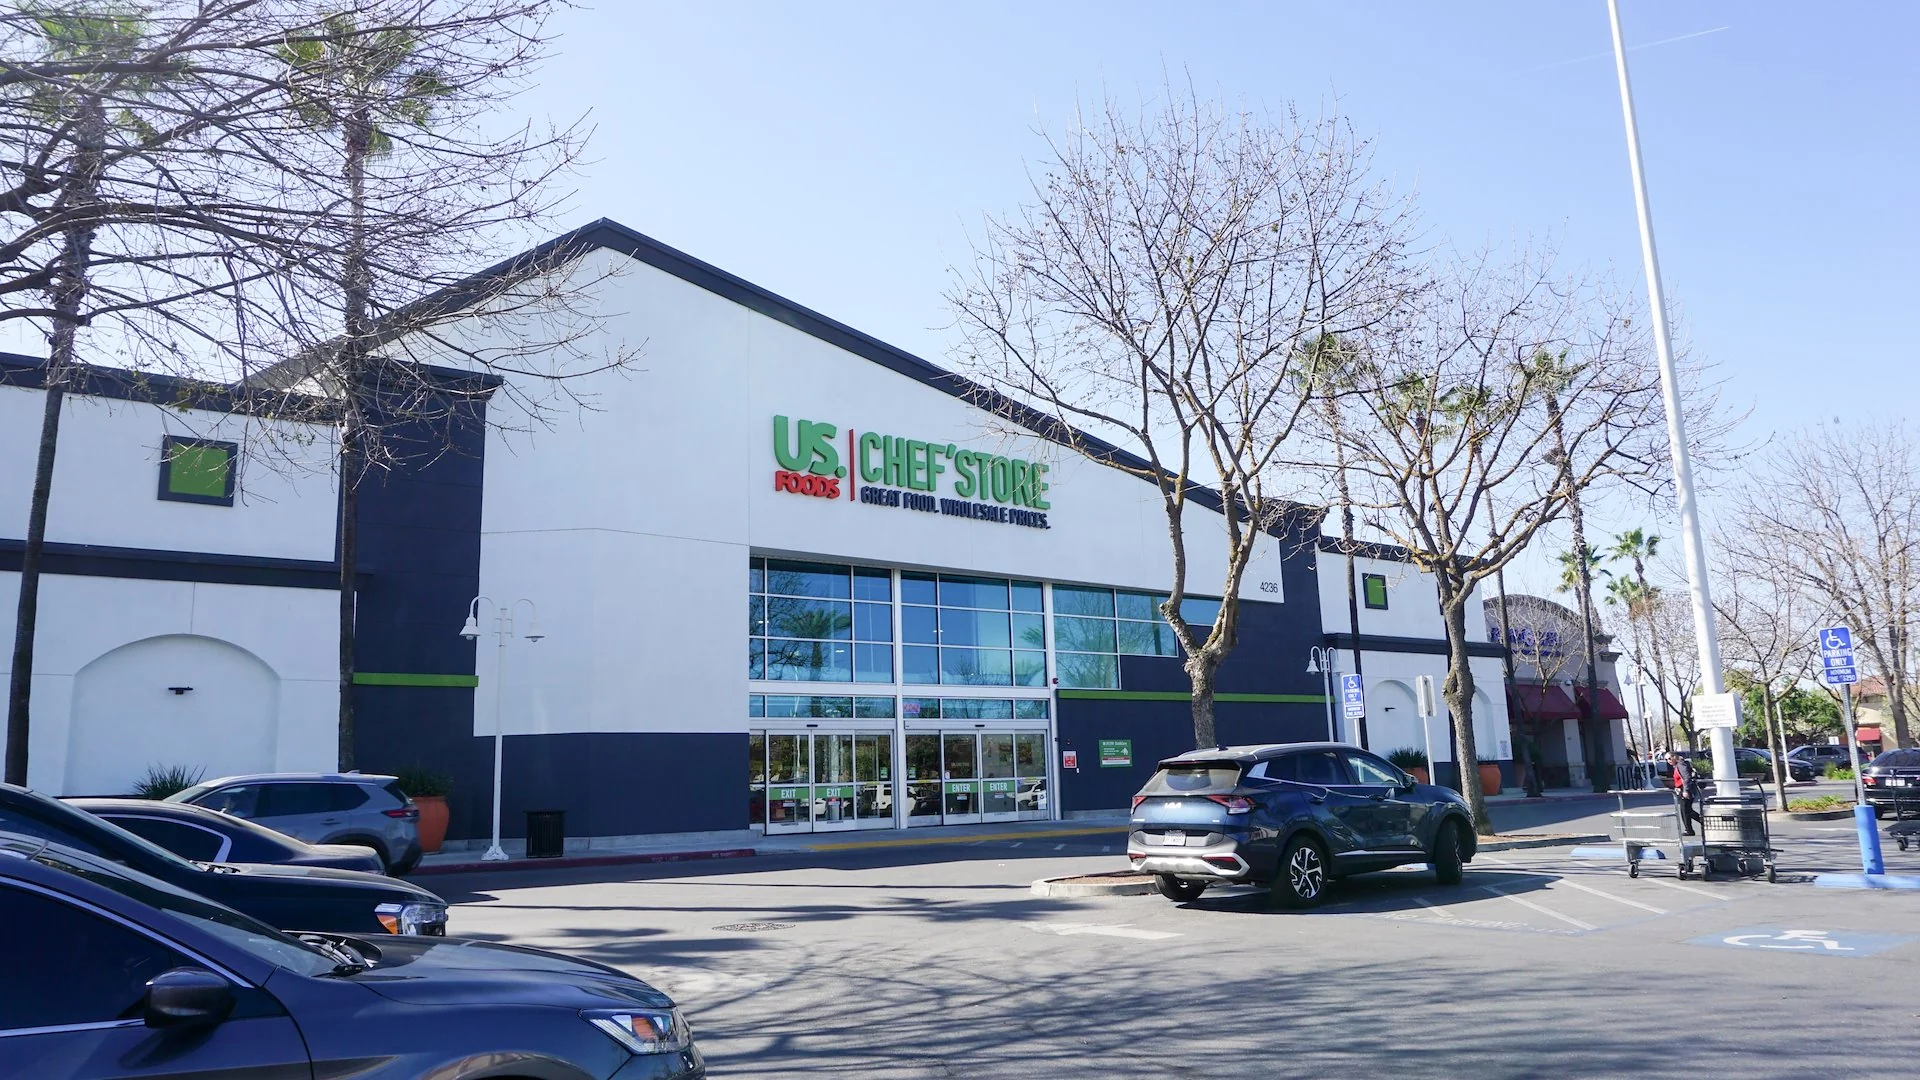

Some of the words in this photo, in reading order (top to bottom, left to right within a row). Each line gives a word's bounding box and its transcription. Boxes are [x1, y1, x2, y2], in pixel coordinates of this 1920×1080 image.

[773, 415, 847, 478] US.
[860, 431, 1051, 510] CHEF'STORE
[775, 470, 840, 499] FOODS
[860, 485, 902, 507] GREAT
[903, 491, 939, 513] FOOD.
[940, 498, 1008, 523] WHOLESALE
[1008, 508, 1051, 530] PRICES.
[1259, 581, 1278, 593] 4236
[1823, 648, 1852, 658] PARKING
[1830, 657, 1847, 666] ONLY
[952, 783, 971, 792] ENTER
[990, 782, 1008, 791] ENTER
[781, 789, 796, 798] EXIT
[826, 788, 841, 797] EXIT
